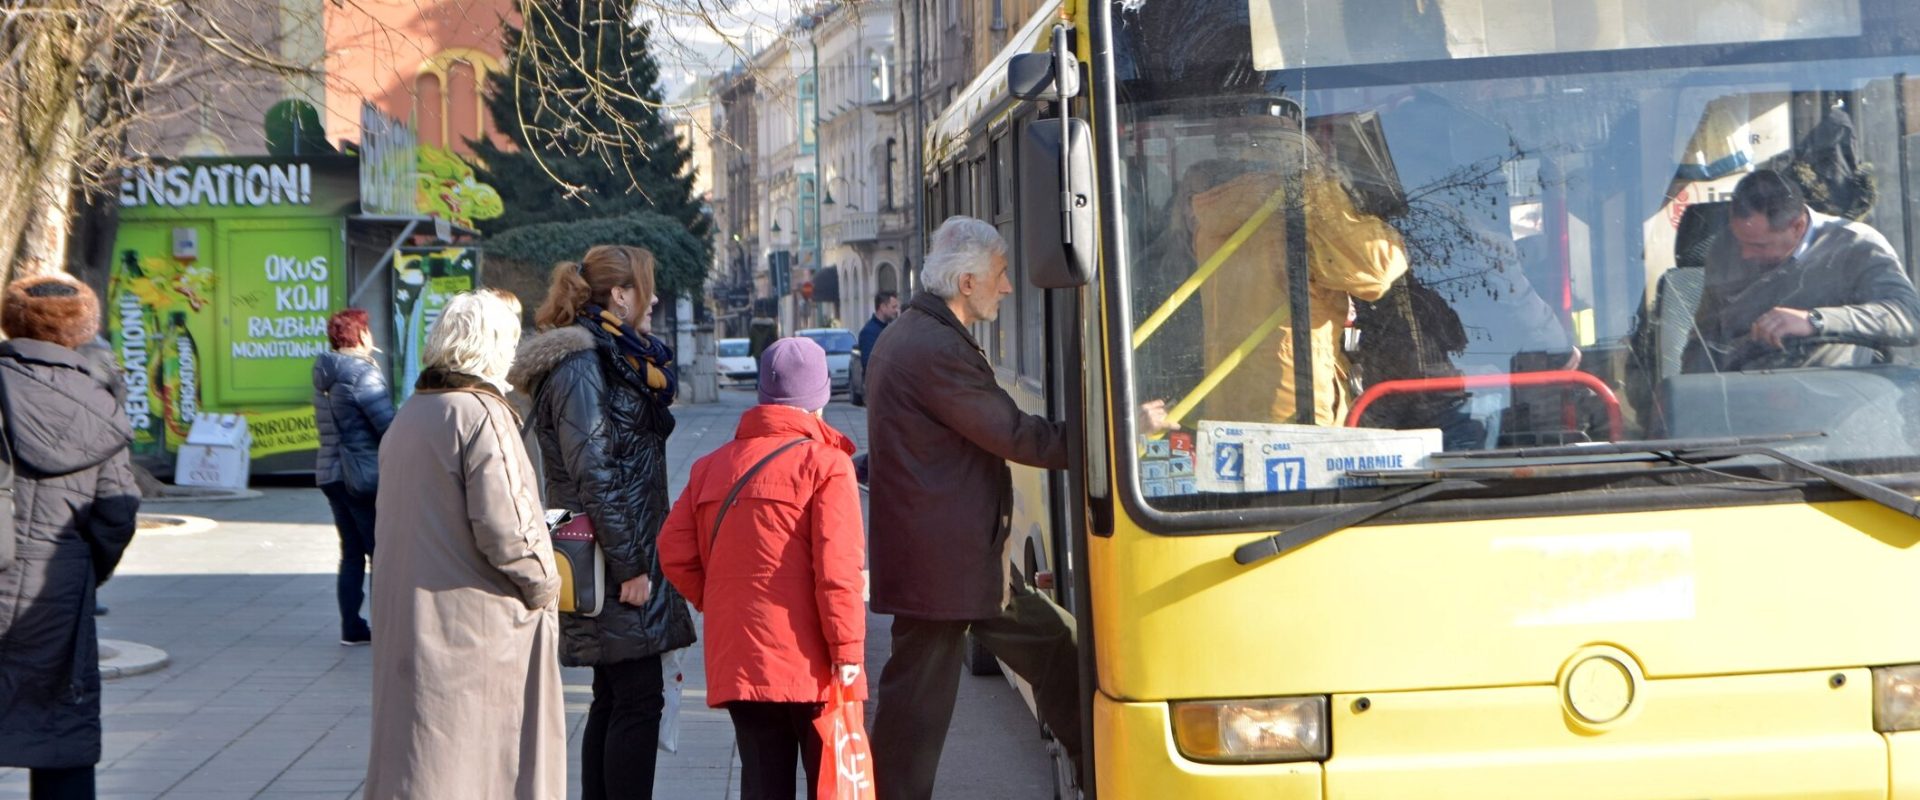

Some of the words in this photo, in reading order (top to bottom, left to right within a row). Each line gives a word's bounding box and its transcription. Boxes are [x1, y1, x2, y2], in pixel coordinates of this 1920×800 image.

[275, 284, 328, 312] KOJI
[1220, 446, 1243, 477] 2
[1272, 461, 1300, 491] 17
[1326, 457, 1355, 471] DOM
[1359, 454, 1403, 470] ARMIJE
